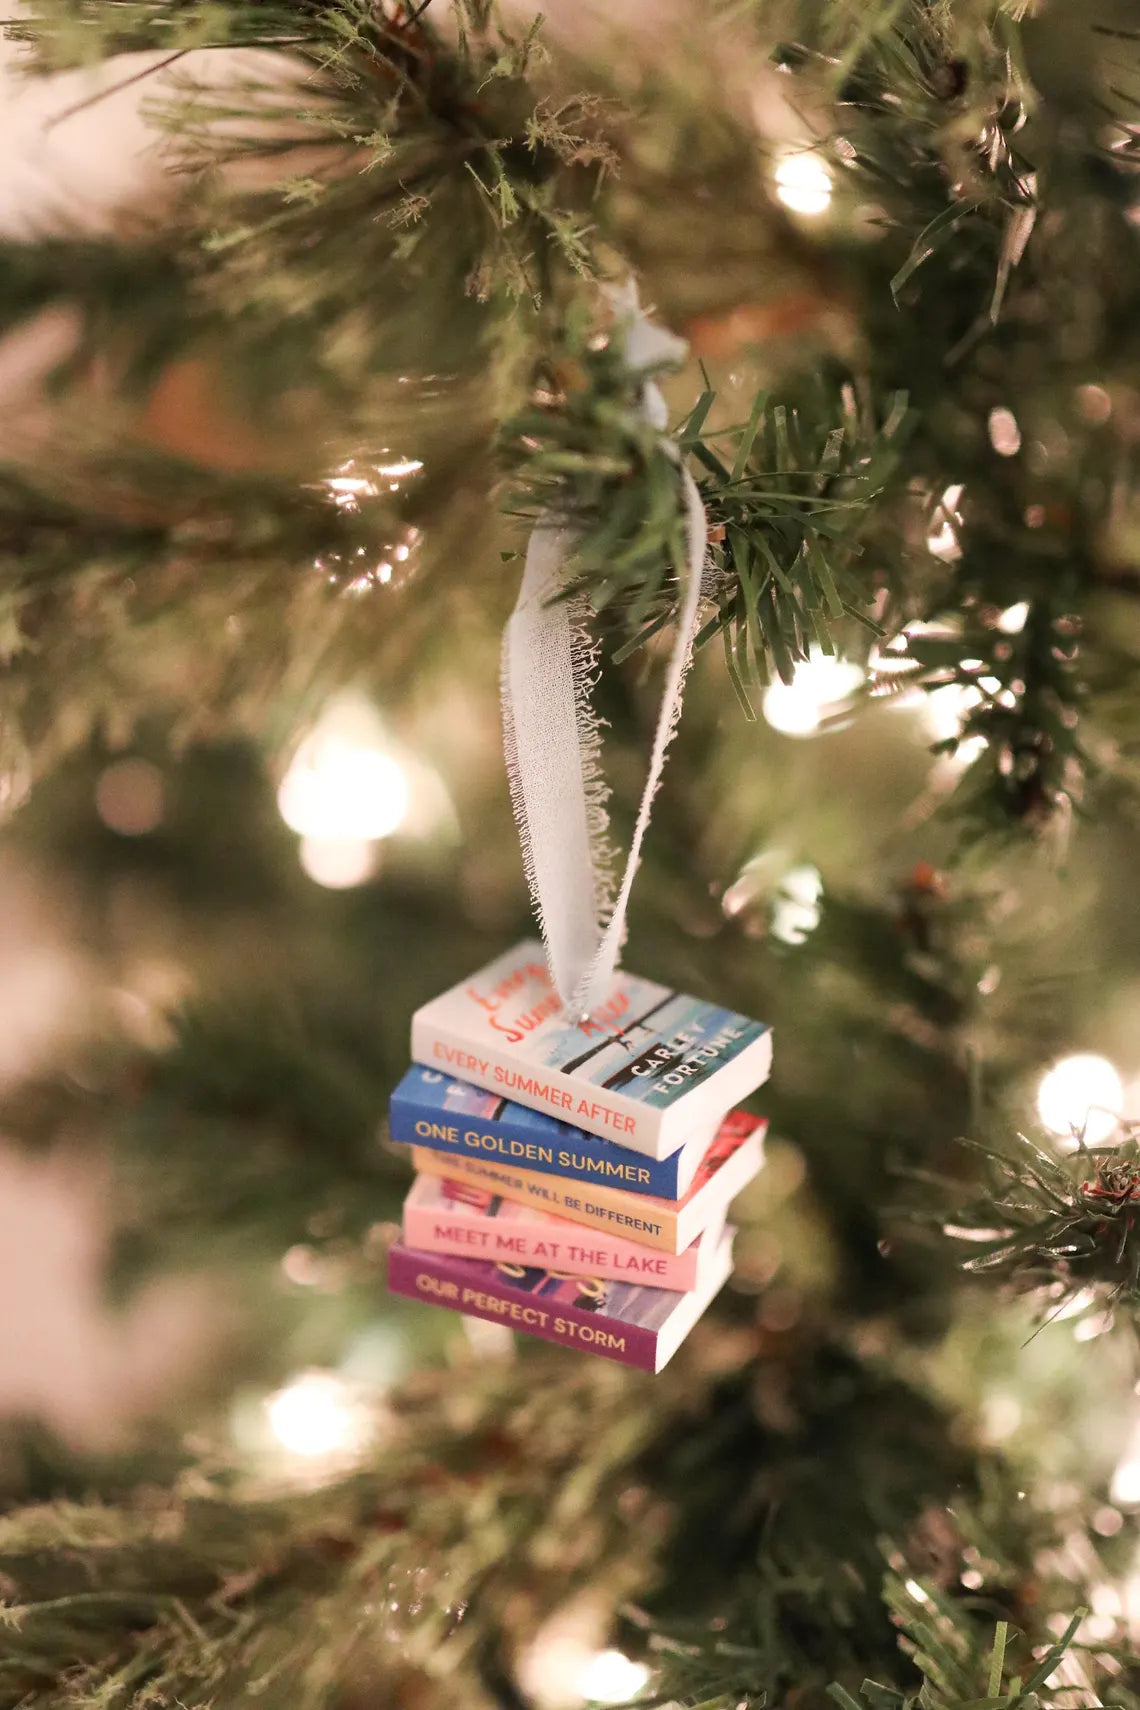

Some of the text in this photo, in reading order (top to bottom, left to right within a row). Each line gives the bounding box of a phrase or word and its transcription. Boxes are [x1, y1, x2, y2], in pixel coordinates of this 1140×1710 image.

[630, 1020, 706, 1077] CARLEY
[651, 1026, 745, 1095] FORTUNE
[433, 1040, 636, 1136] EVERY SUMMER AFTER
[414, 1120, 651, 1185] ONE GOLDEN SUMMER
[527, 1182, 560, 1204] WILL
[564, 1195, 582, 1211] BE
[585, 1202, 663, 1237] DIFFERENT
[434, 1225, 668, 1276] MEET ME AT THE LAKE
[415, 1273, 459, 1299] OUR
[462, 1287, 549, 1329] PERFECT
[553, 1317, 627, 1354] STORM
